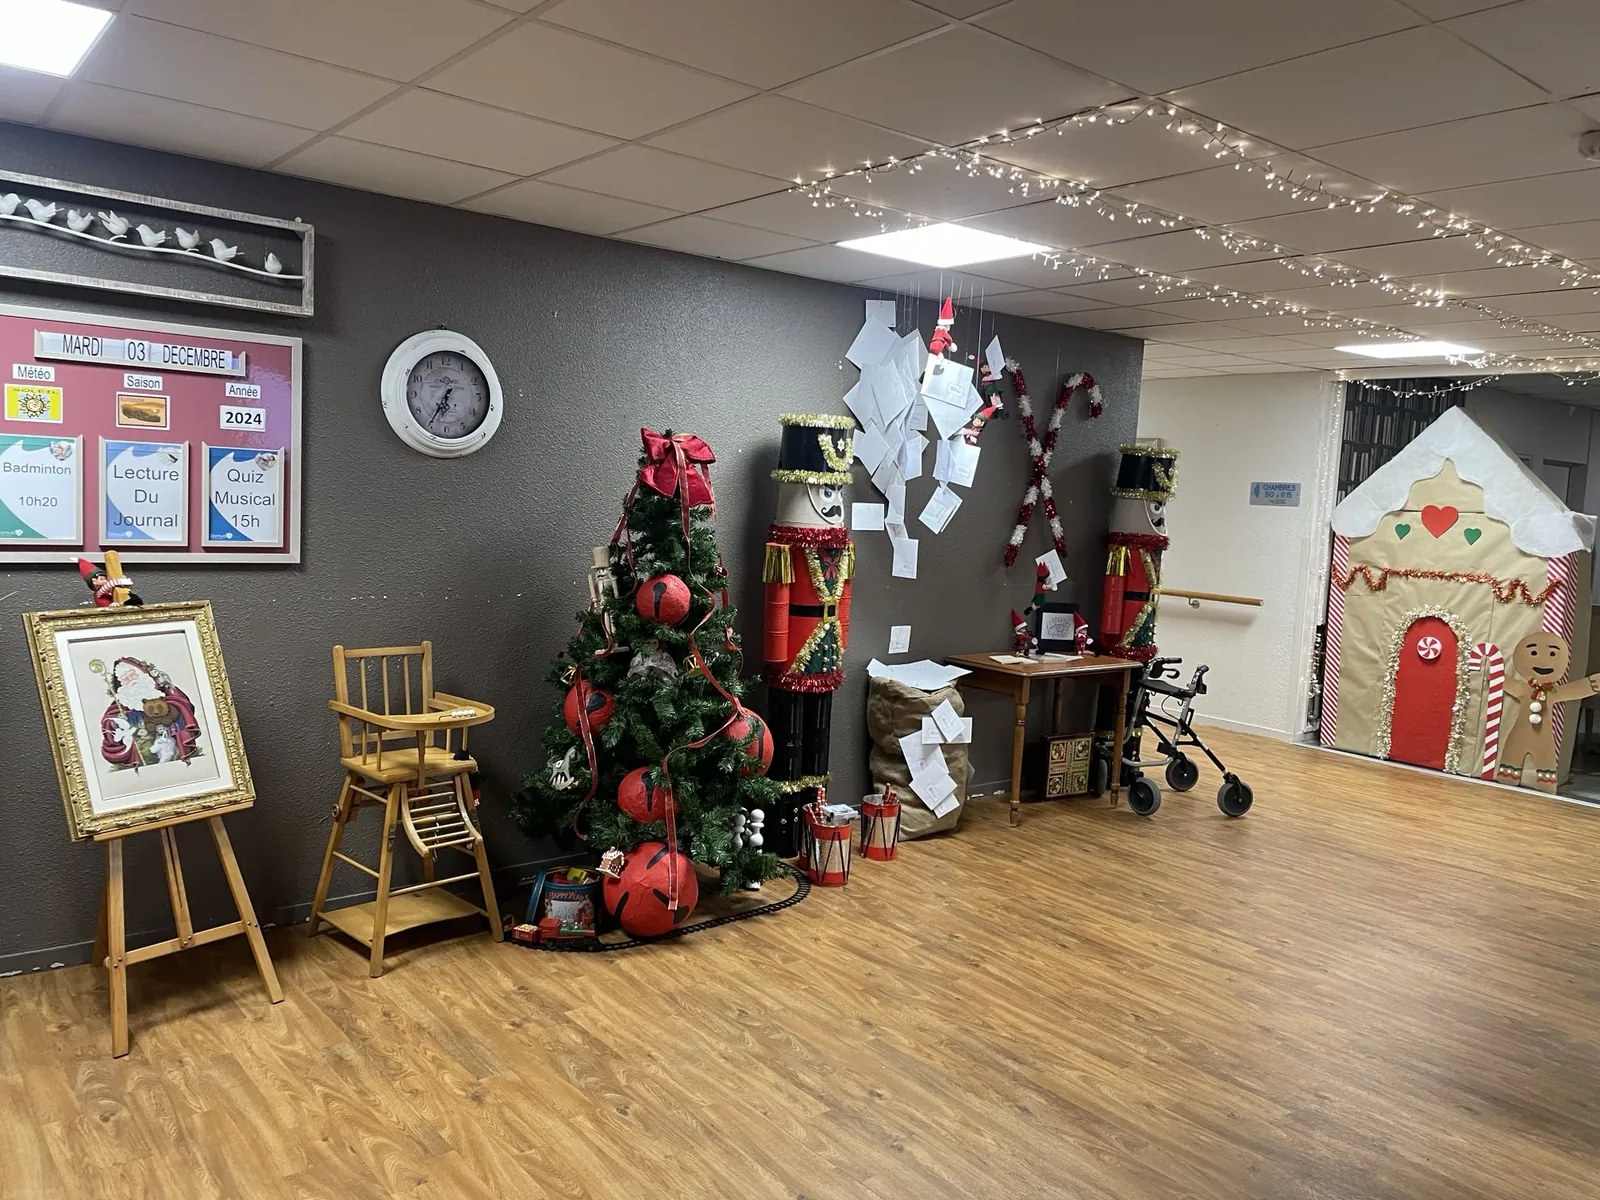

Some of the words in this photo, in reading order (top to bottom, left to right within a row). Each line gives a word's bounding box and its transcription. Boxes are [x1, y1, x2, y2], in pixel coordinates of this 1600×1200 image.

[62, 335, 103, 356] MARDI
[128, 342, 145, 361] 03
[163, 345, 225, 368] DECEMBRE
[427, 360, 432, 369] 11
[442, 356, 450, 366] 12
[18, 366, 50, 380] Météo
[414, 374, 422, 383] 10
[127, 375, 160, 388] Saison
[229, 385, 258, 397] Année
[226, 412, 262, 425] 2024
[3, 462, 71, 475] Badminton
[114, 465, 179, 481] Lecture
[227, 469, 264, 483] Quiz
[20, 496, 58, 507] 10h20
[134, 490, 158, 503] Du
[215, 491, 274, 506] Musical
[114, 512, 178, 527] Journal
[232, 515, 260, 527] 15h
